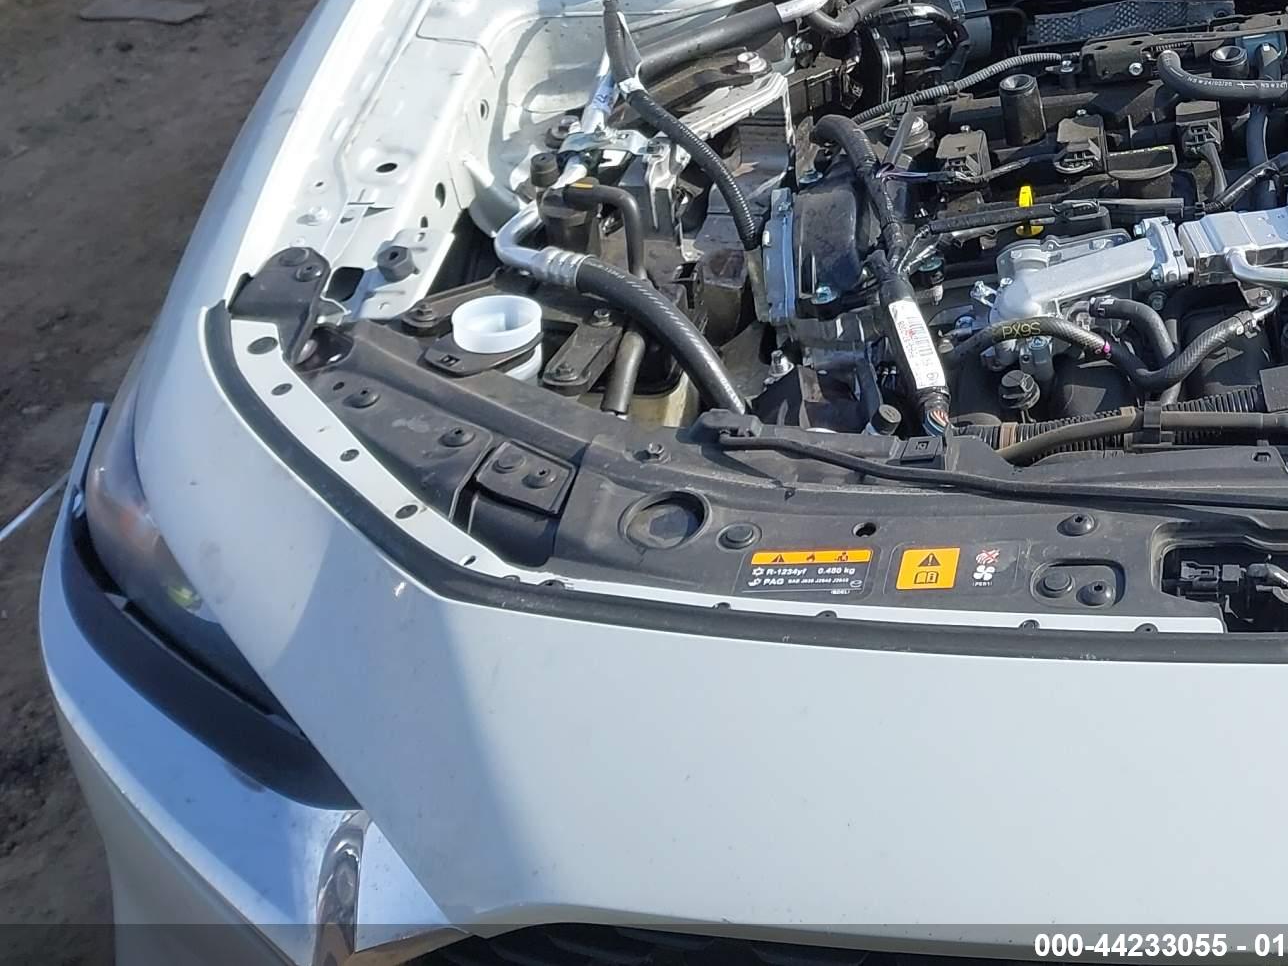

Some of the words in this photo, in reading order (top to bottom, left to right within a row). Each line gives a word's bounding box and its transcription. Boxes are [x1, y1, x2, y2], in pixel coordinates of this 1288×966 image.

[1002, 321, 1041, 339] PX9S
[766, 567, 807, 577] R-1234yf
[843, 567, 856, 575] kg
